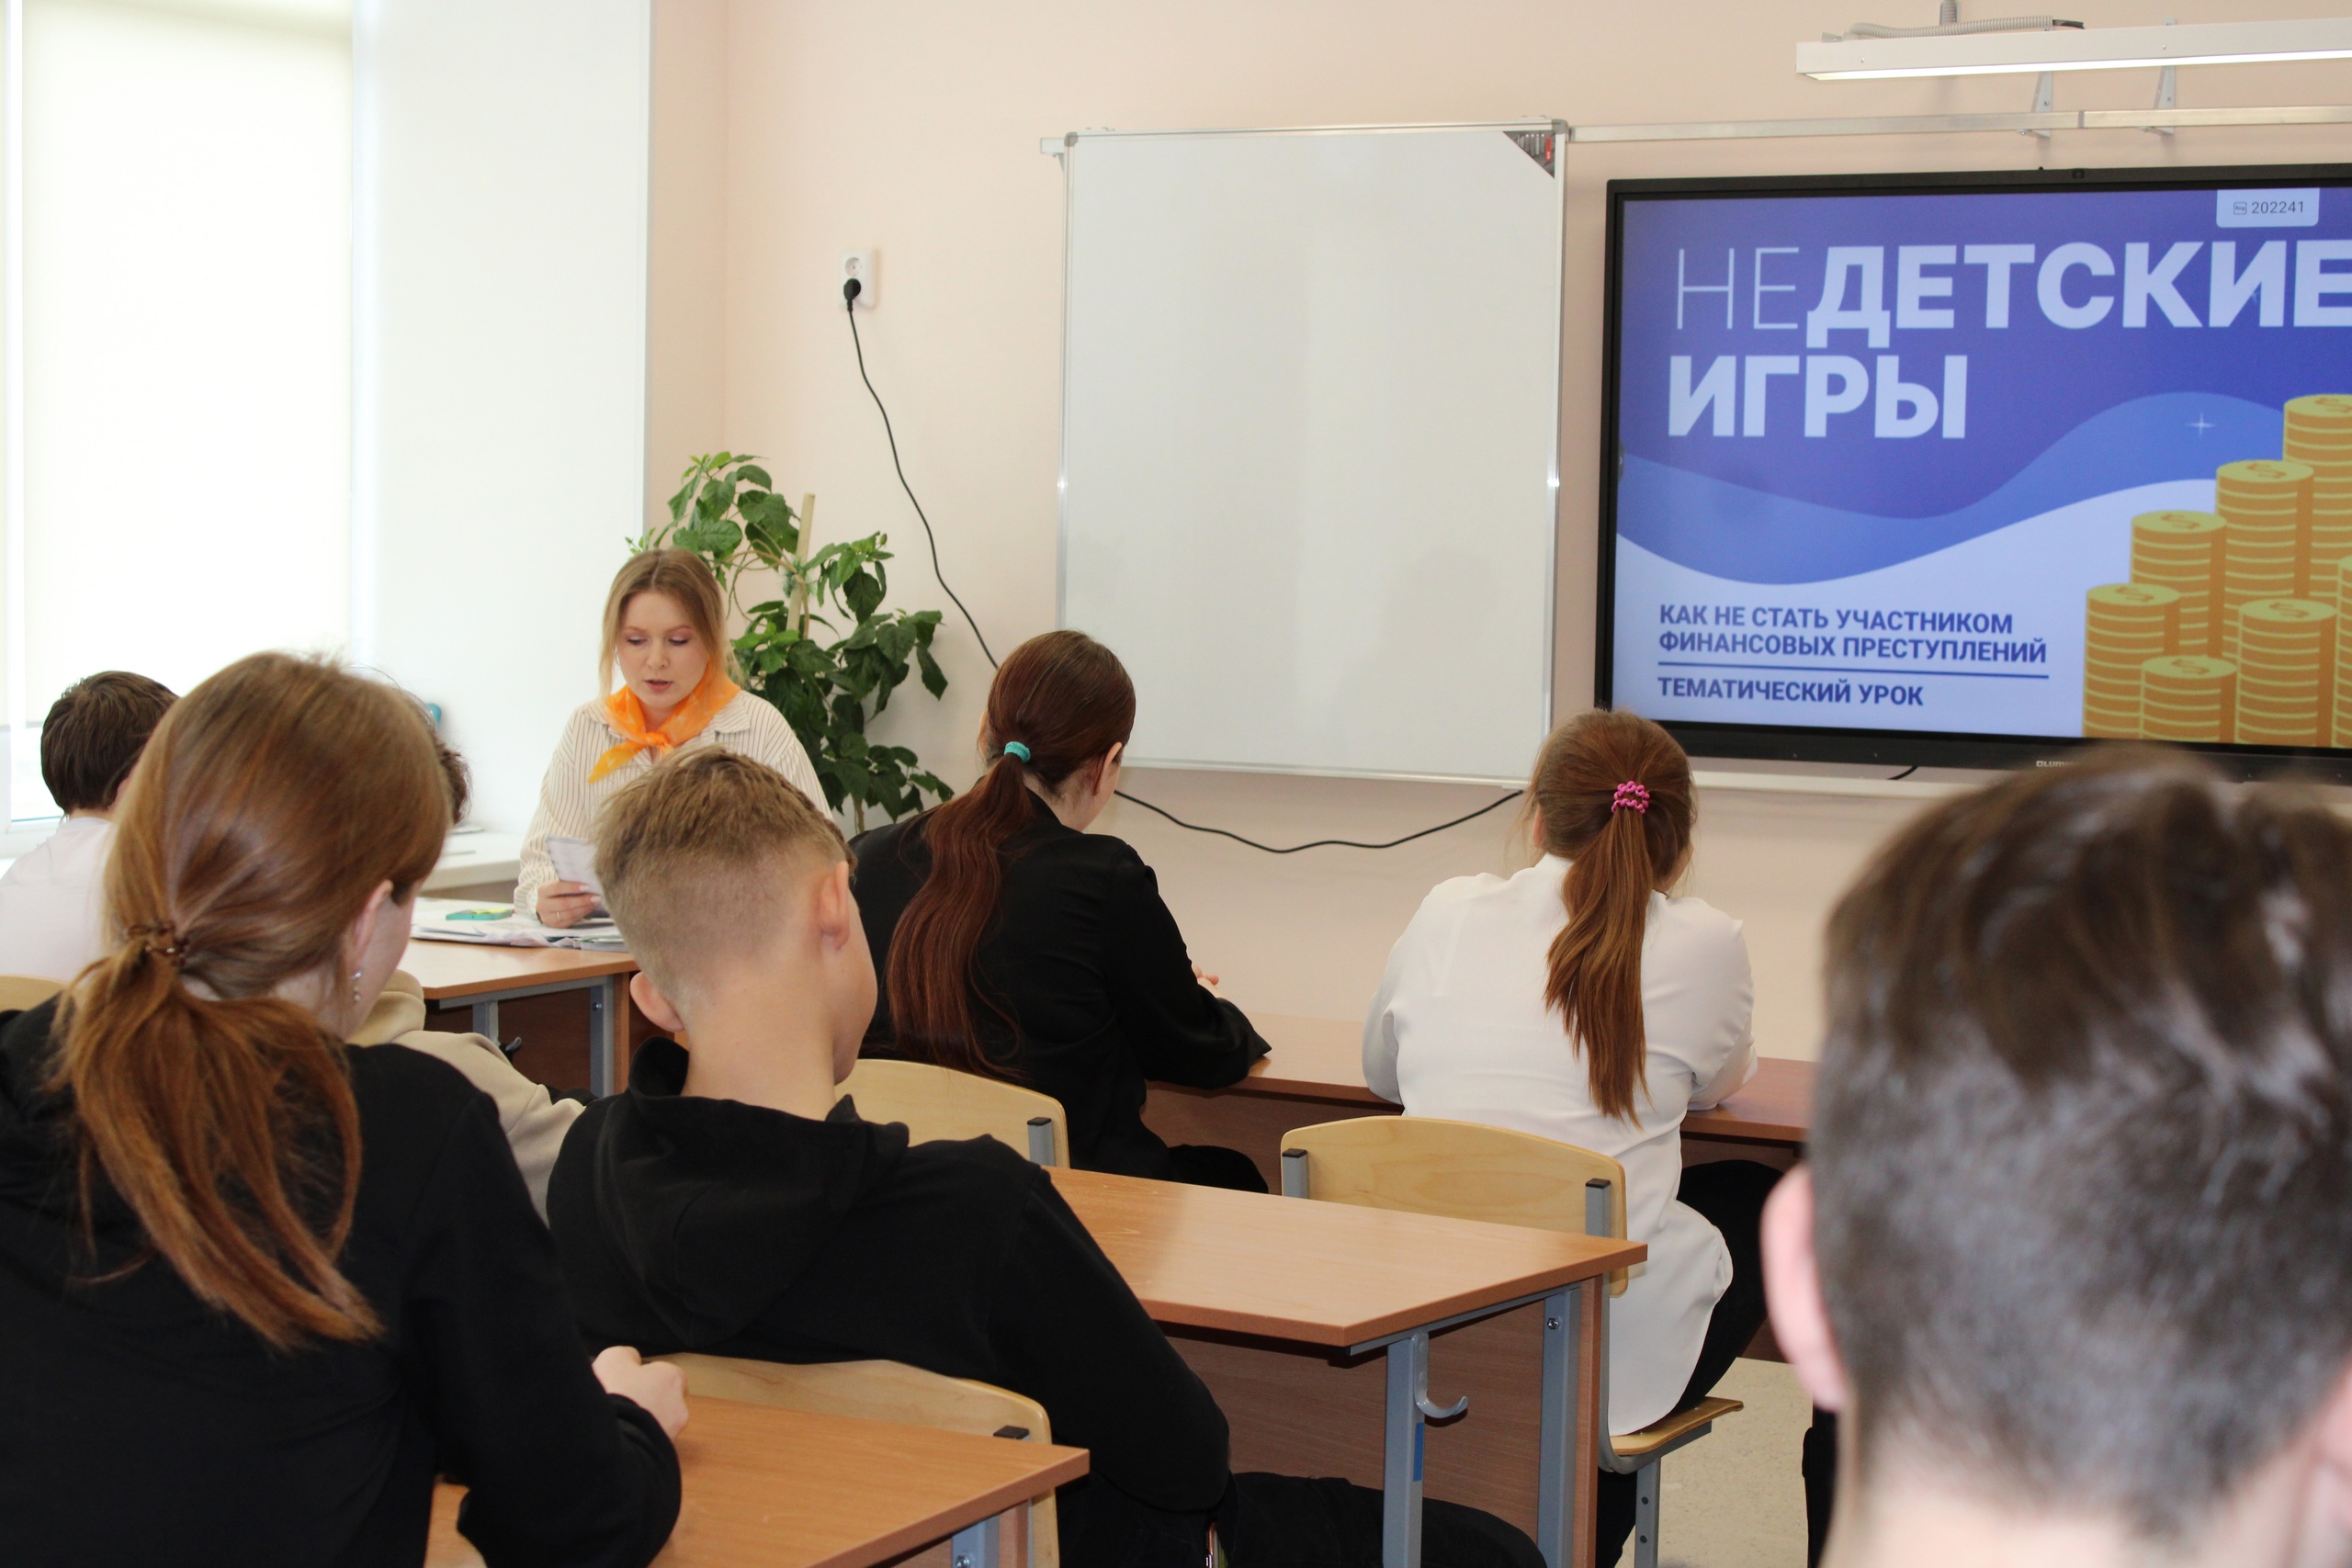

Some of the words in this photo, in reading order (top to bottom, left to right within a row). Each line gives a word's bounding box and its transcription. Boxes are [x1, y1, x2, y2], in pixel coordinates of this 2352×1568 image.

[2251, 201, 2303, 214] 202241
[1668, 355, 1967, 438] ИГРЫ
[1660, 605, 1708, 626] КАК
[1715, 607, 1746, 626] НЕ
[1752, 608, 1828, 628] СТАТЬ
[1837, 611, 2013, 634] УЧАСТНИКОМ
[1659, 631, 1837, 657] ФИНАНСОВЫХ
[1843, 637, 2048, 663] ПРЕСТУПЛЕНИЙ
[1658, 677, 1851, 704] ТЕМАТИЧЕСКИЙ
[1859, 685, 1924, 706] УРОК
